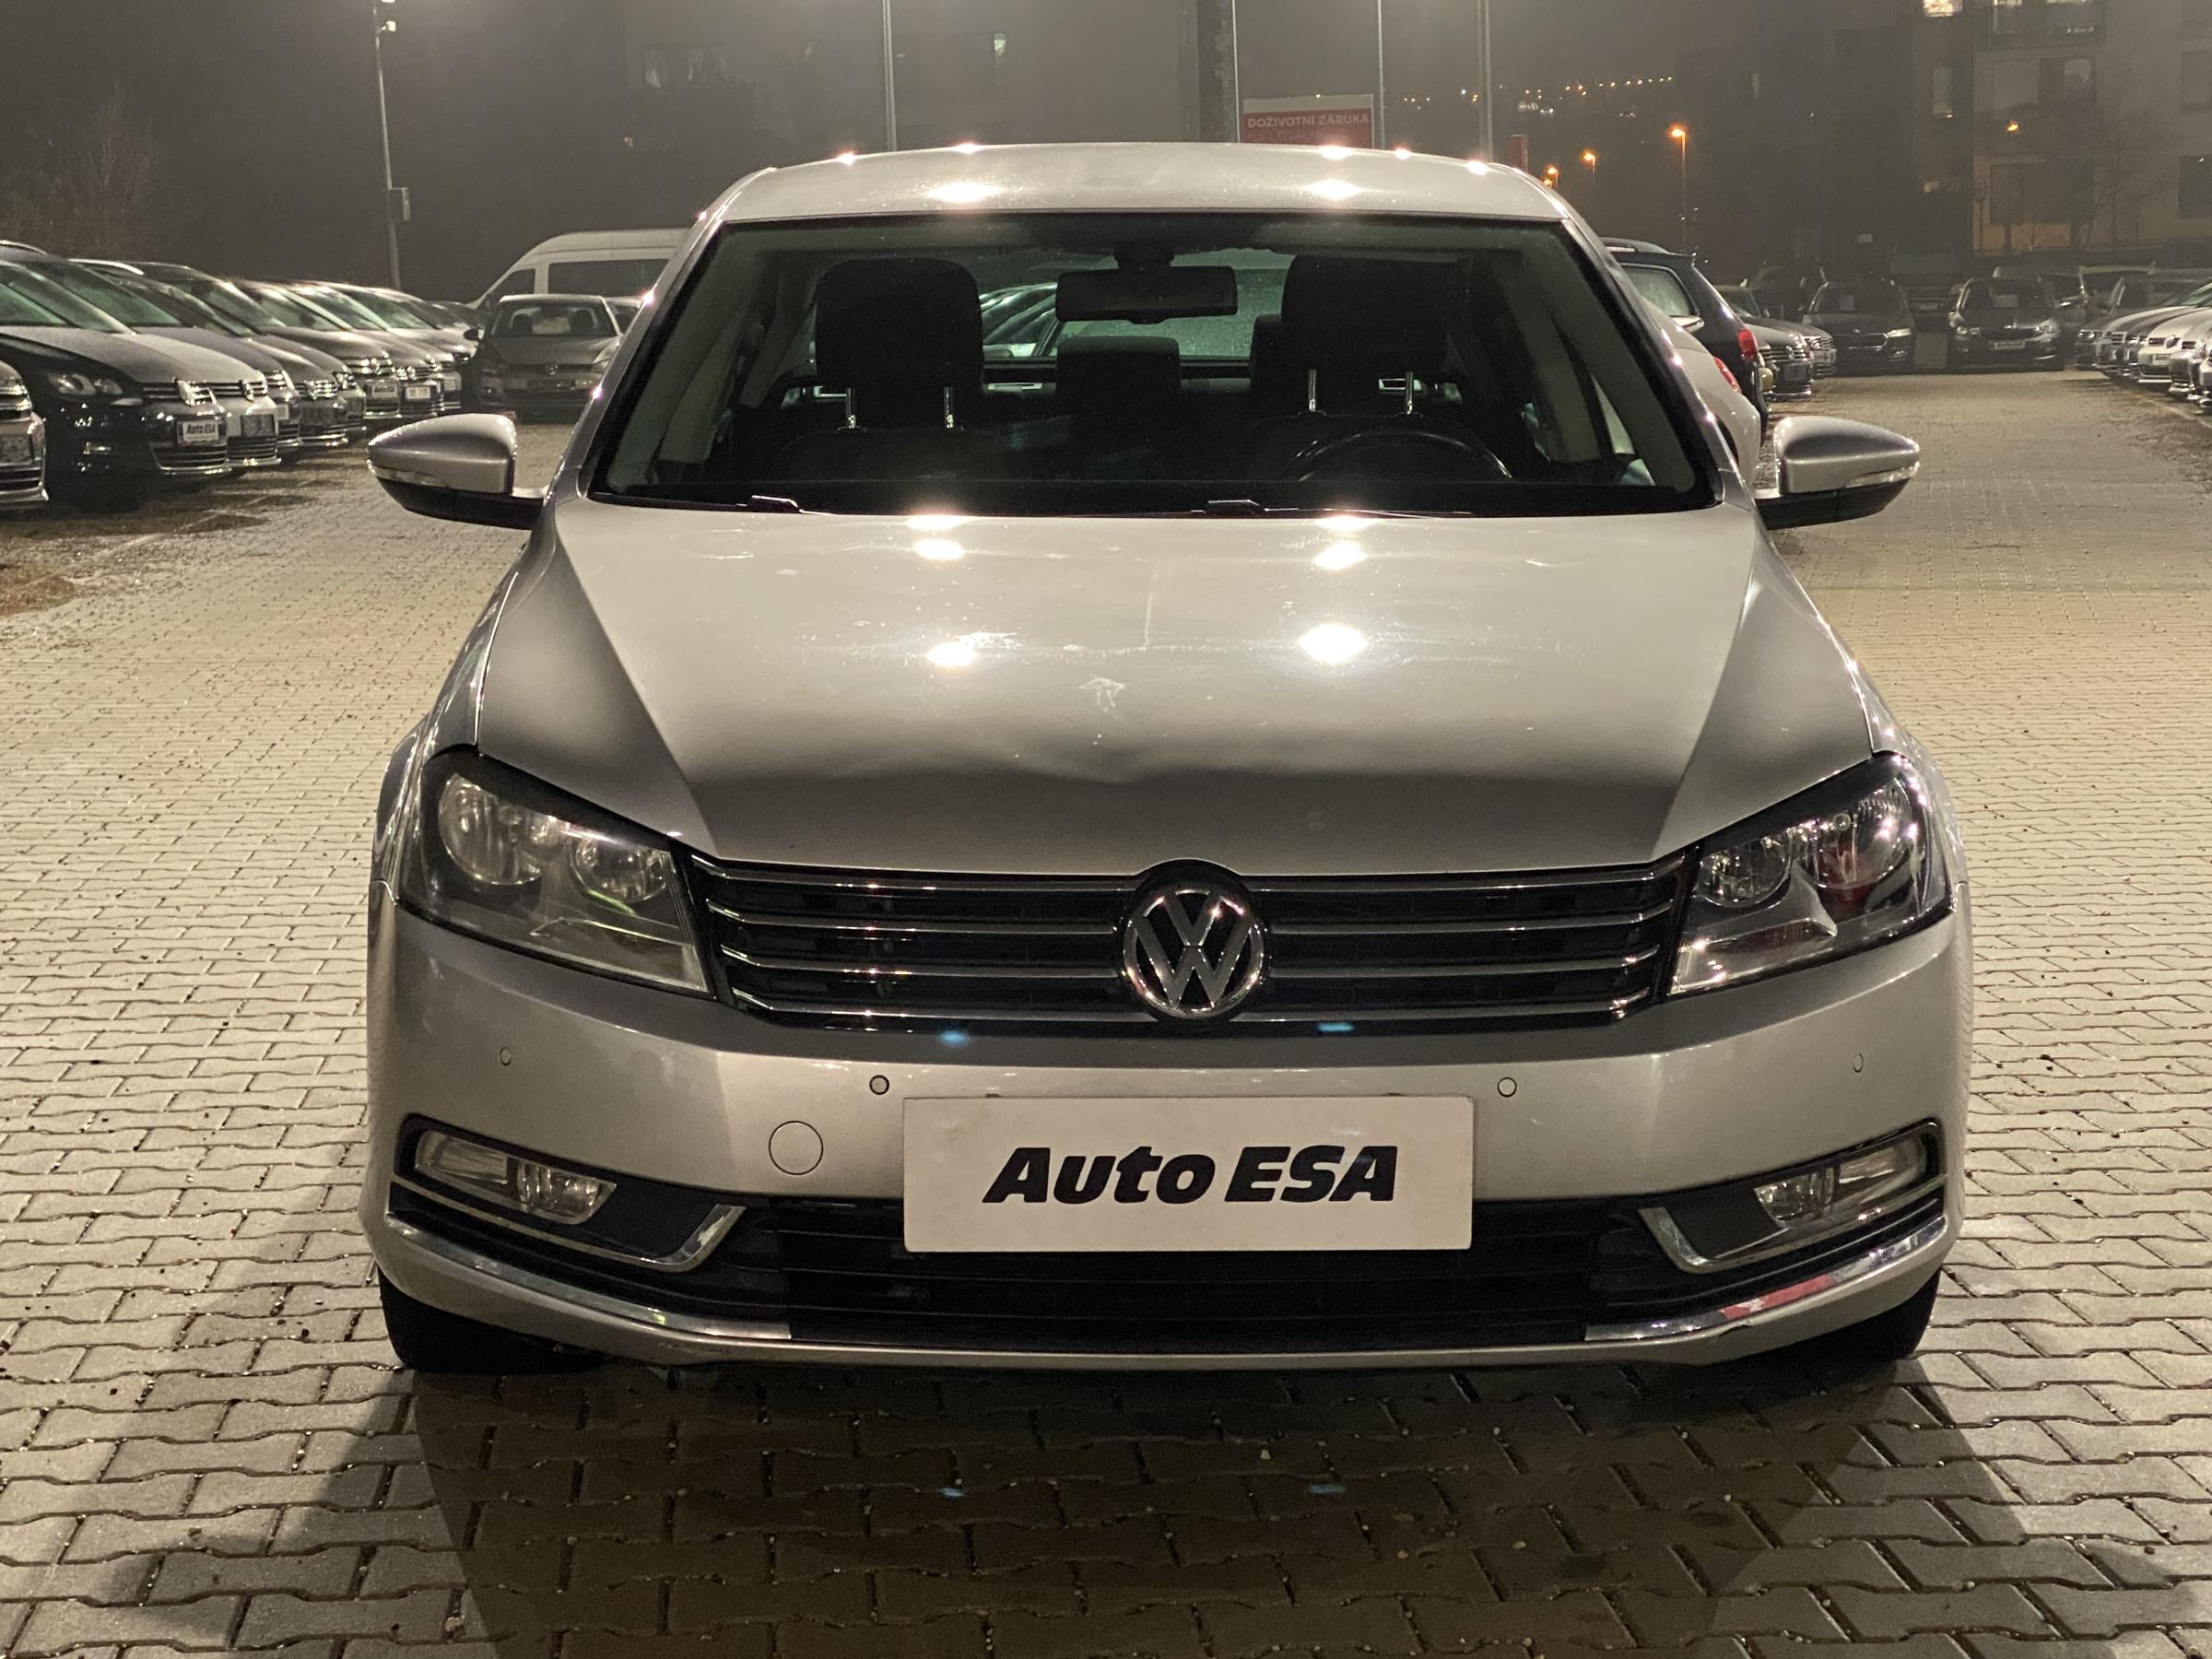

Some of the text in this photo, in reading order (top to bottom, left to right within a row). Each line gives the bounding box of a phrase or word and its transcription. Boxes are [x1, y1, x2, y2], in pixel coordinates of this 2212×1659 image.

[1317, 112, 1370, 125] ZÁRUKA
[186, 424, 204, 434] Auto
[982, 1145, 1397, 1204] Auto ESA
